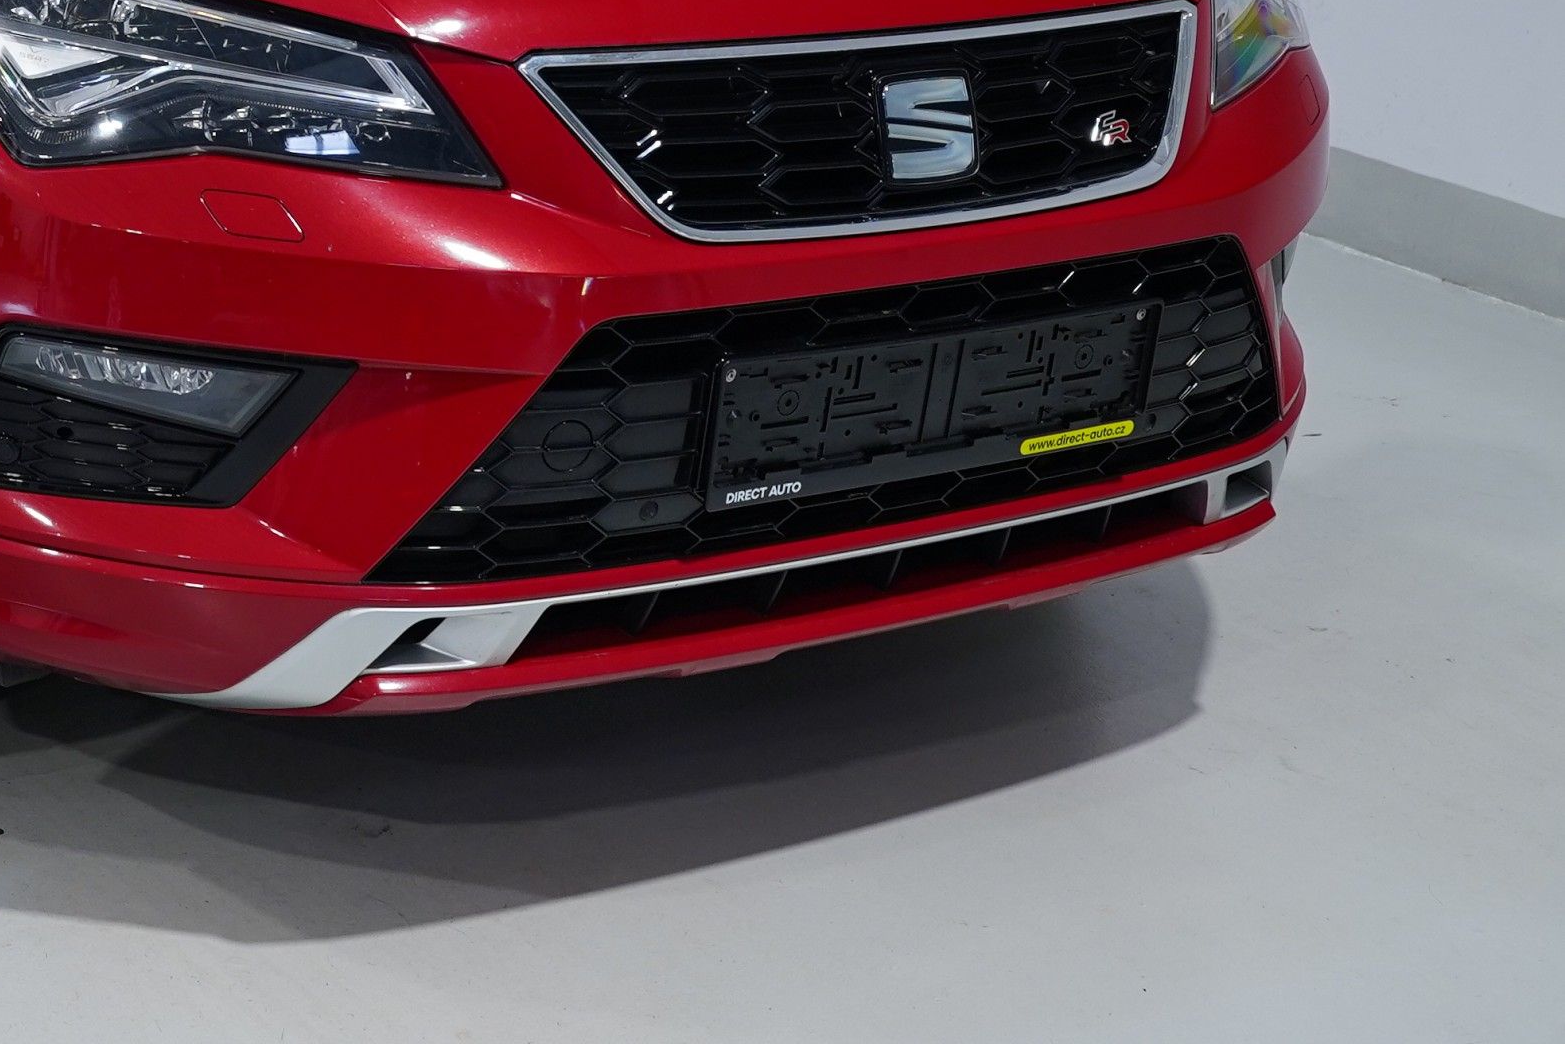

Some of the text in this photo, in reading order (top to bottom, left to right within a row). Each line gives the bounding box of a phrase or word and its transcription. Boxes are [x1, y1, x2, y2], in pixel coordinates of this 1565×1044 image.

[1028, 425, 1127, 452] www.direct-auto.cz
[725, 481, 802, 505] DIRECT AUTO
